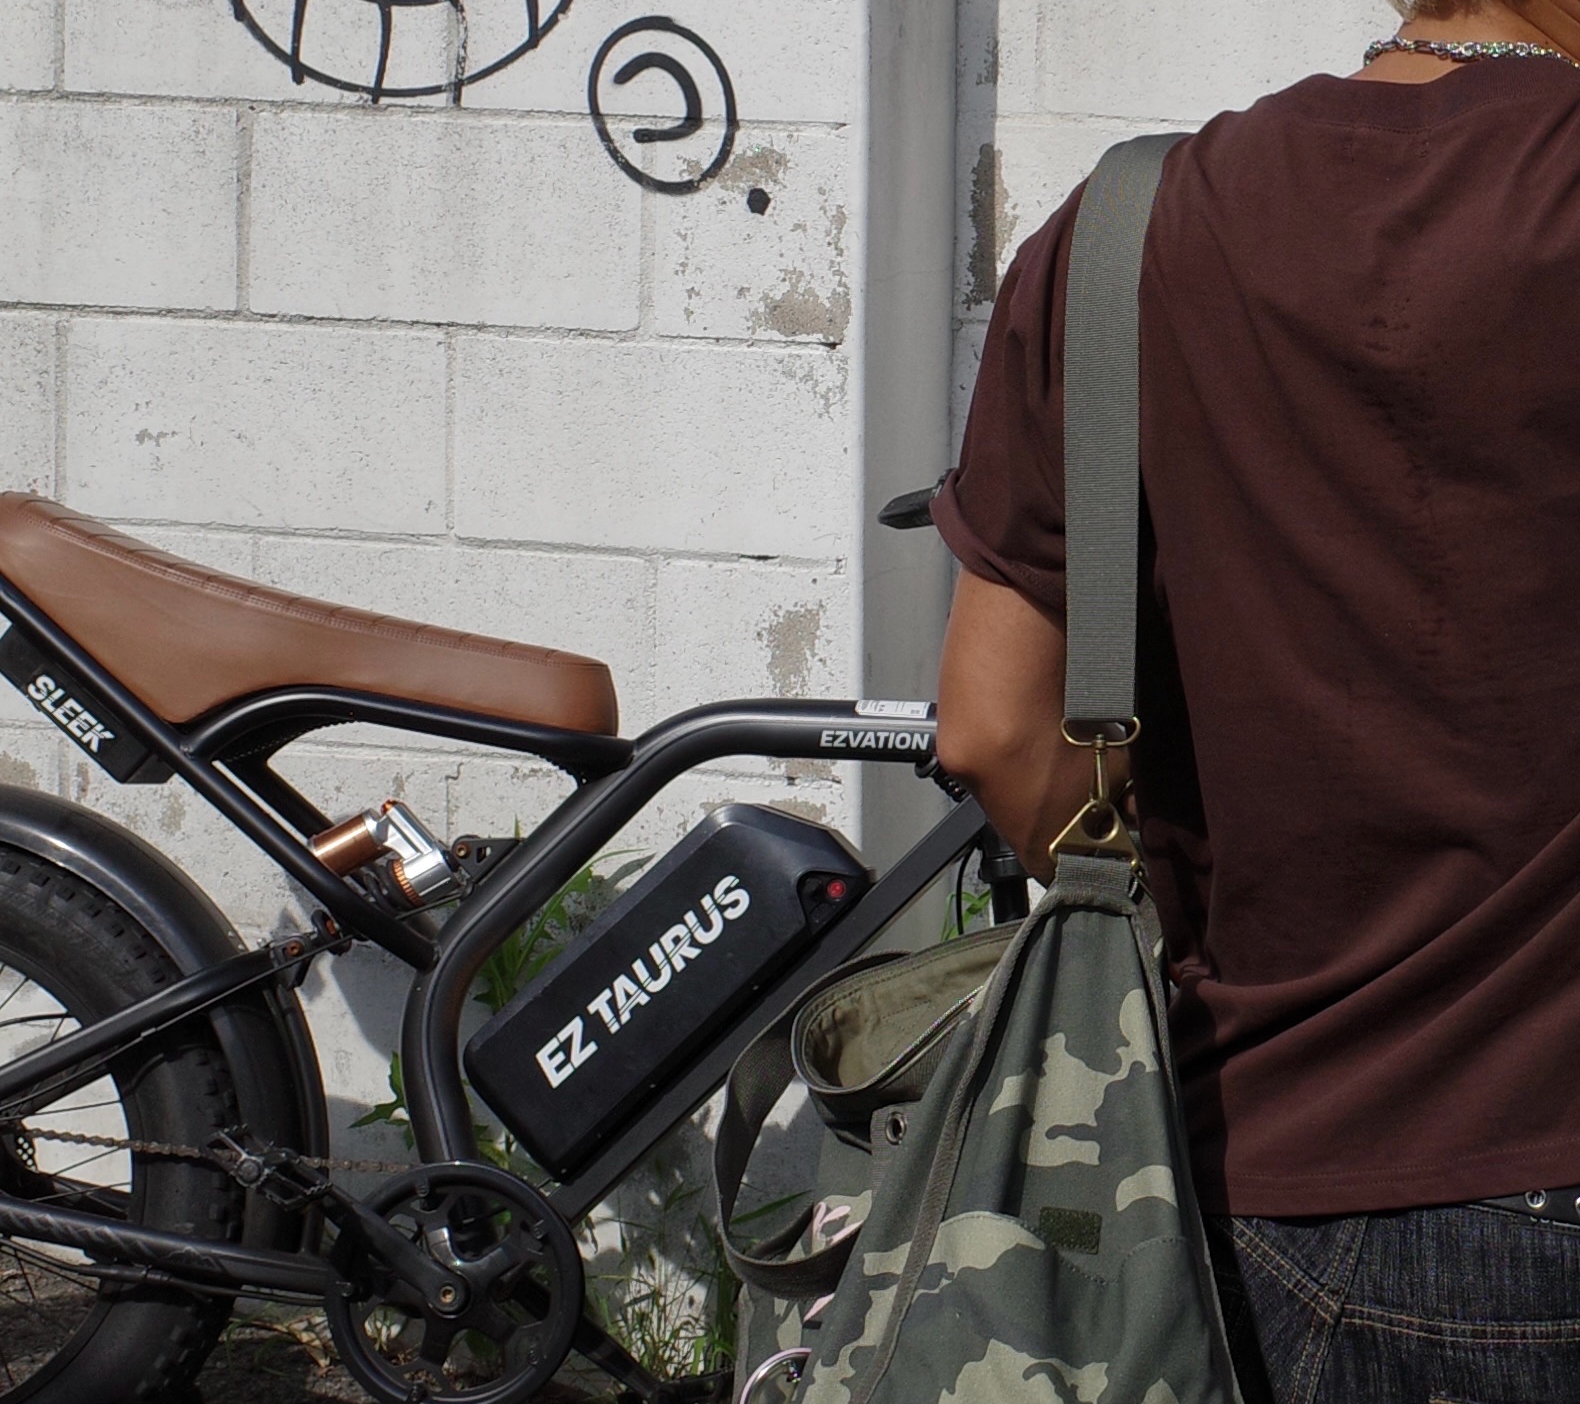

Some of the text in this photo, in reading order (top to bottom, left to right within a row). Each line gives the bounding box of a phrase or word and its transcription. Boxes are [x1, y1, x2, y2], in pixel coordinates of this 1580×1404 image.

[27, 674, 115, 754] SLEEK
[820, 729, 930, 751] EZVATION
[534, 874, 751, 1089] EZ TAURUS
